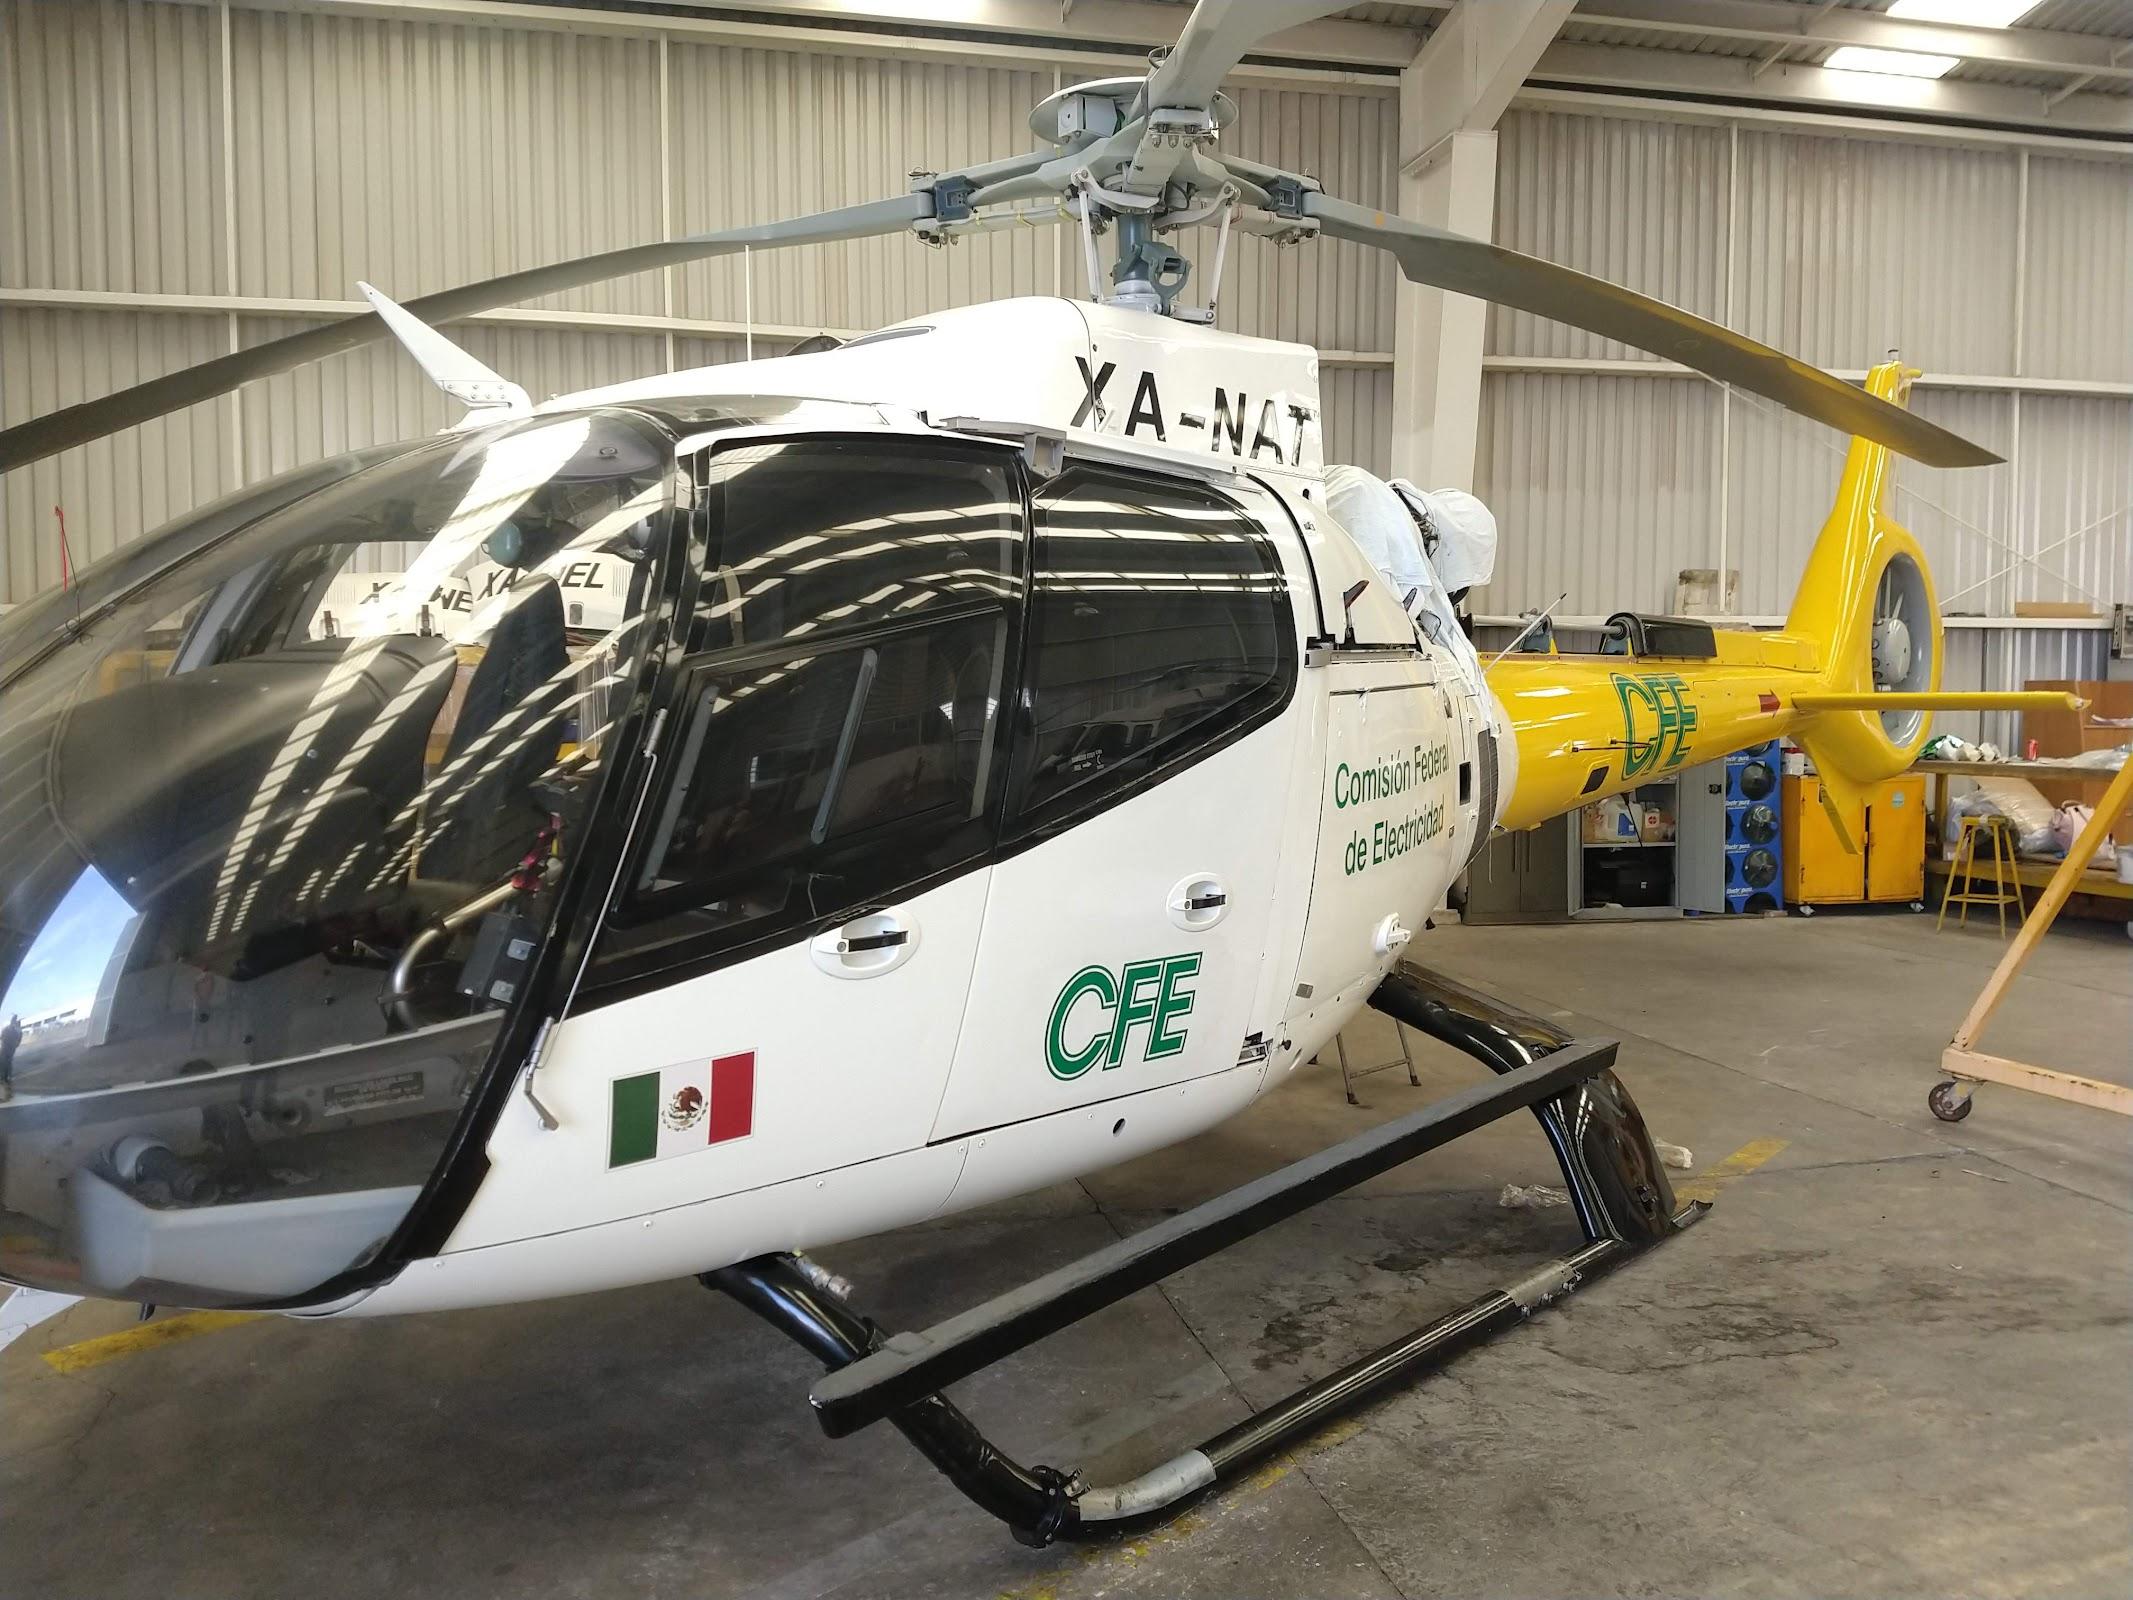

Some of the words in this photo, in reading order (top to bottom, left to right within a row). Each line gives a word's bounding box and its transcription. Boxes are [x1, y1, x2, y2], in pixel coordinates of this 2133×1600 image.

[1070, 355, 1313, 467] XA-NAT
[1334, 749, 1411, 809] Comisión
[1414, 734, 1450, 786] Federal
[1609, 672, 1698, 780] CFE
[1345, 830, 1367, 876] de
[1373, 794, 1445, 865] Electricidad
[1045, 951, 1203, 1081] CFE
